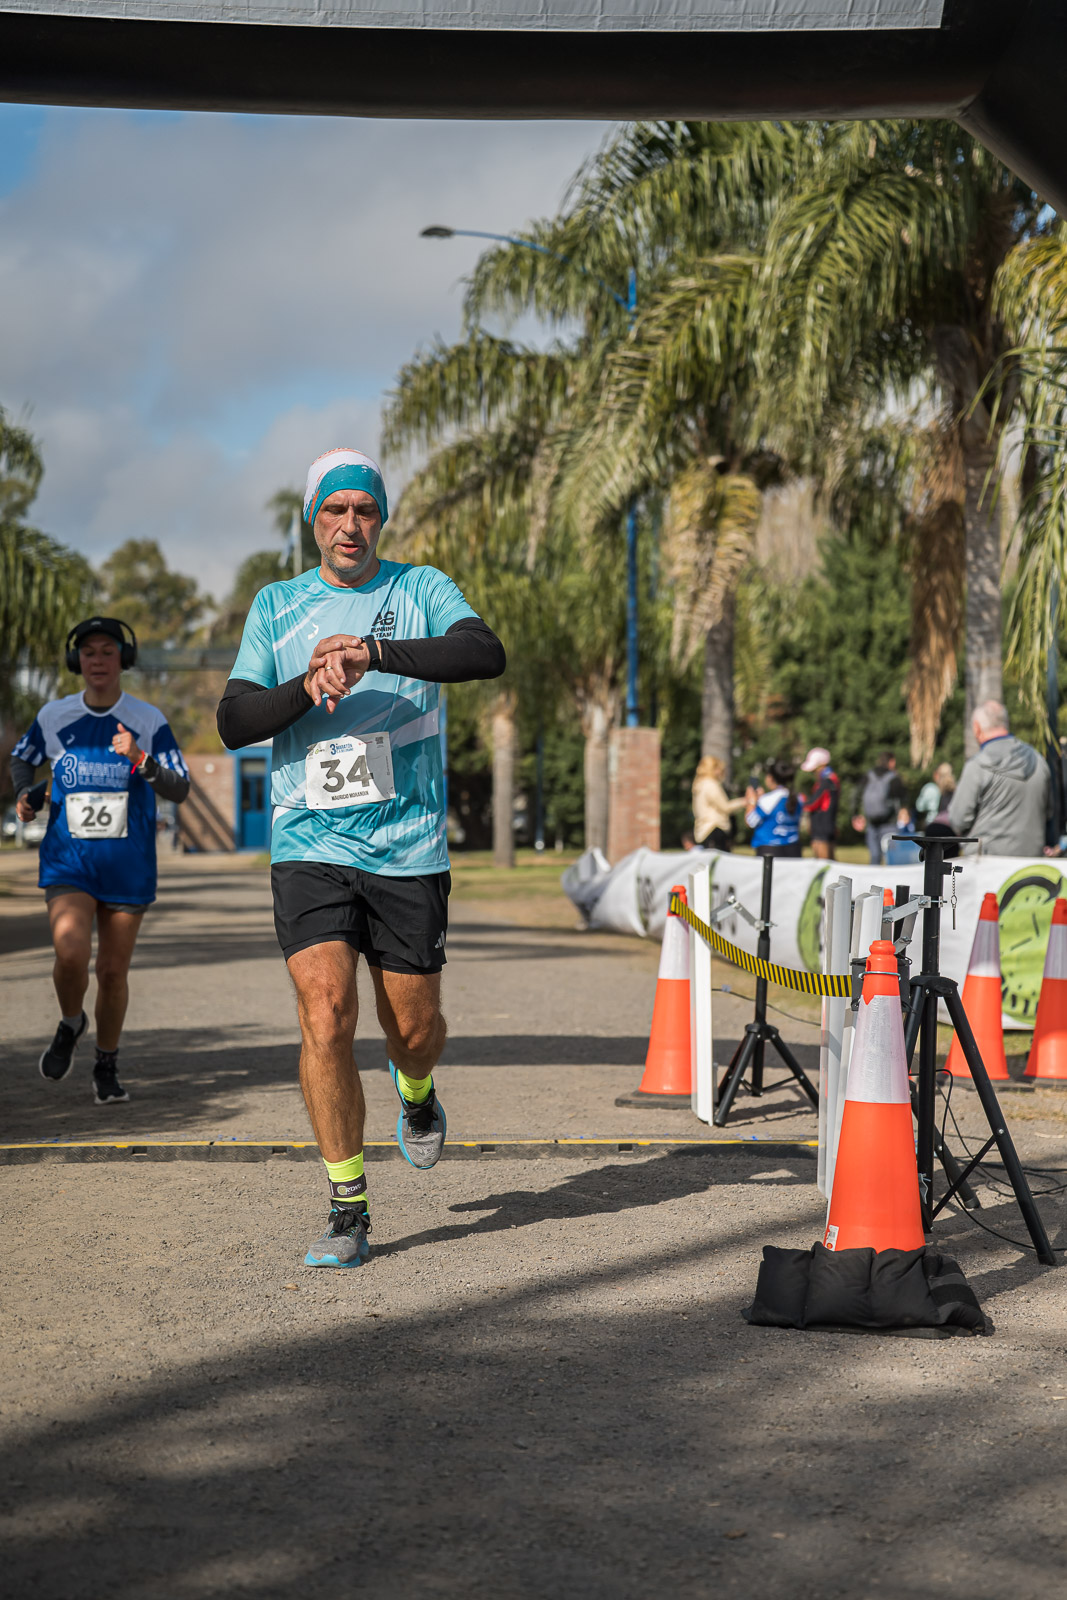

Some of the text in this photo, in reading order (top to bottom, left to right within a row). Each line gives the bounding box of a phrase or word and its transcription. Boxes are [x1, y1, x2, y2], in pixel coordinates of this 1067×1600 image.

[371, 625, 395, 633] RUNNING
[320, 755, 370, 793] 34
[81, 806, 112, 827] 26
